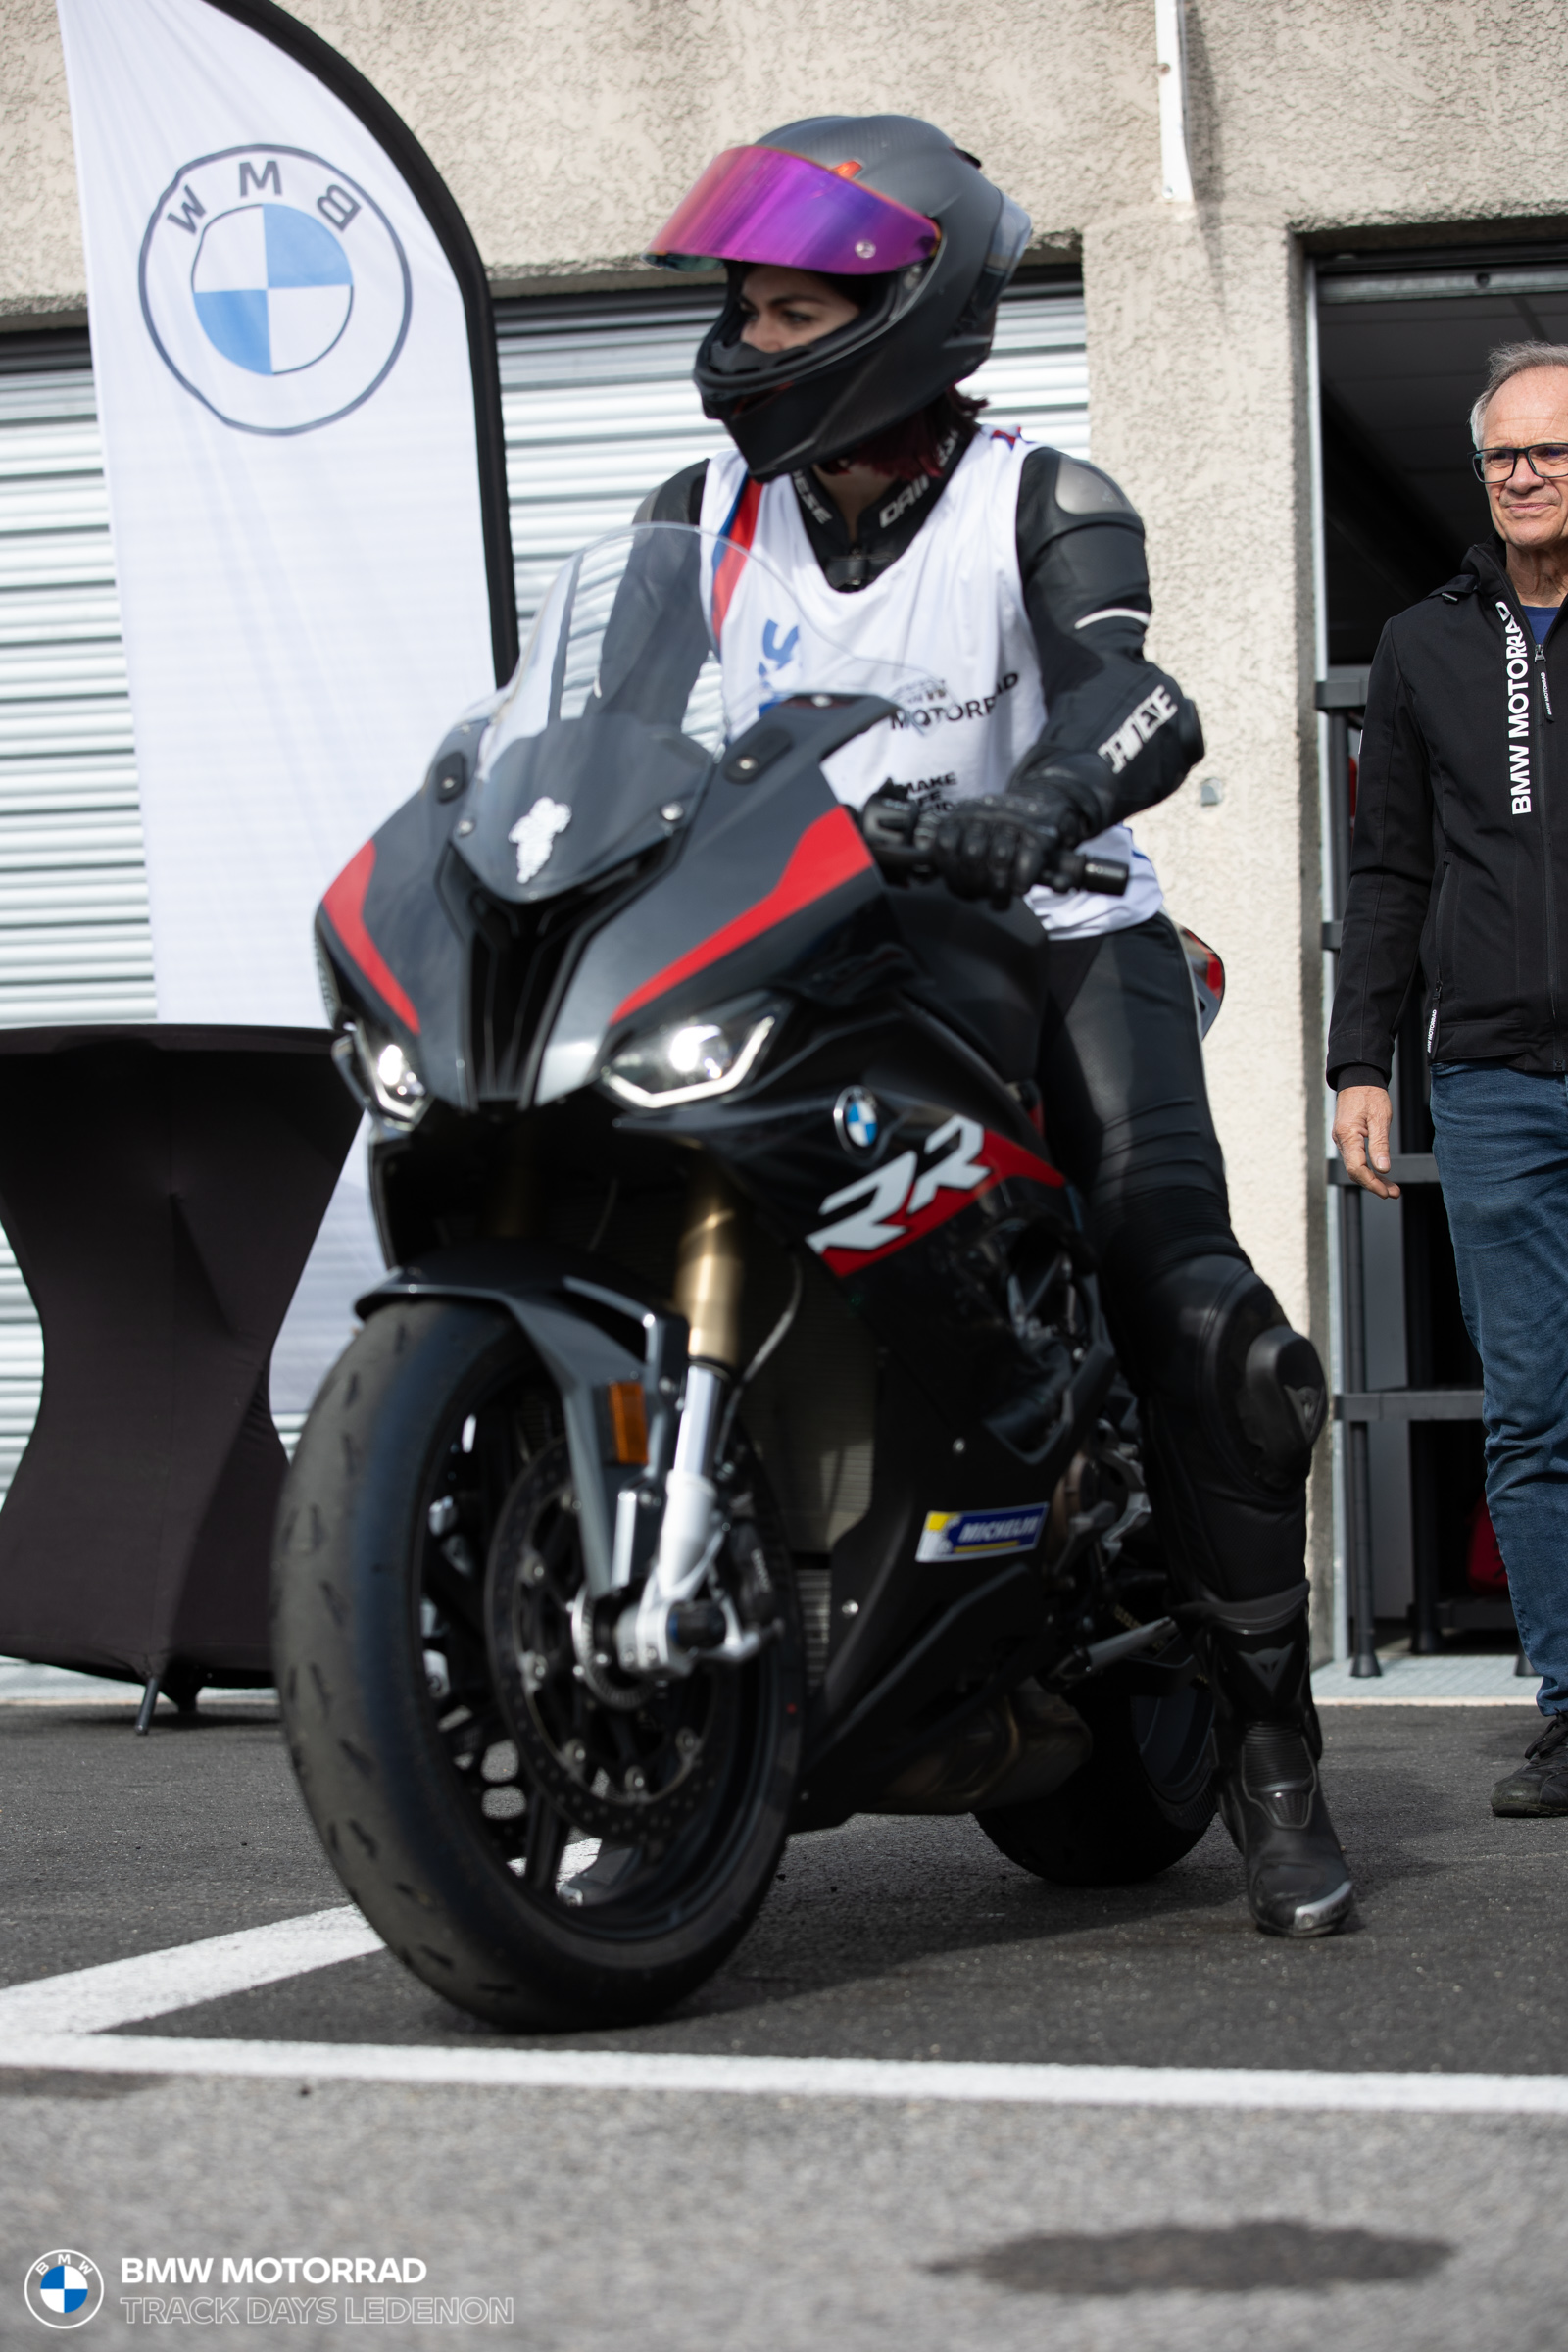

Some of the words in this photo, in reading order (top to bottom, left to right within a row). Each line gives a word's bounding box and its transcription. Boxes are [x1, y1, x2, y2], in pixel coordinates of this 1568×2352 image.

[1495, 601, 1530, 739] MOTORRAD
[1508, 744, 1532, 815] BMW
[957, 1515, 1042, 1544] MICHELIN
